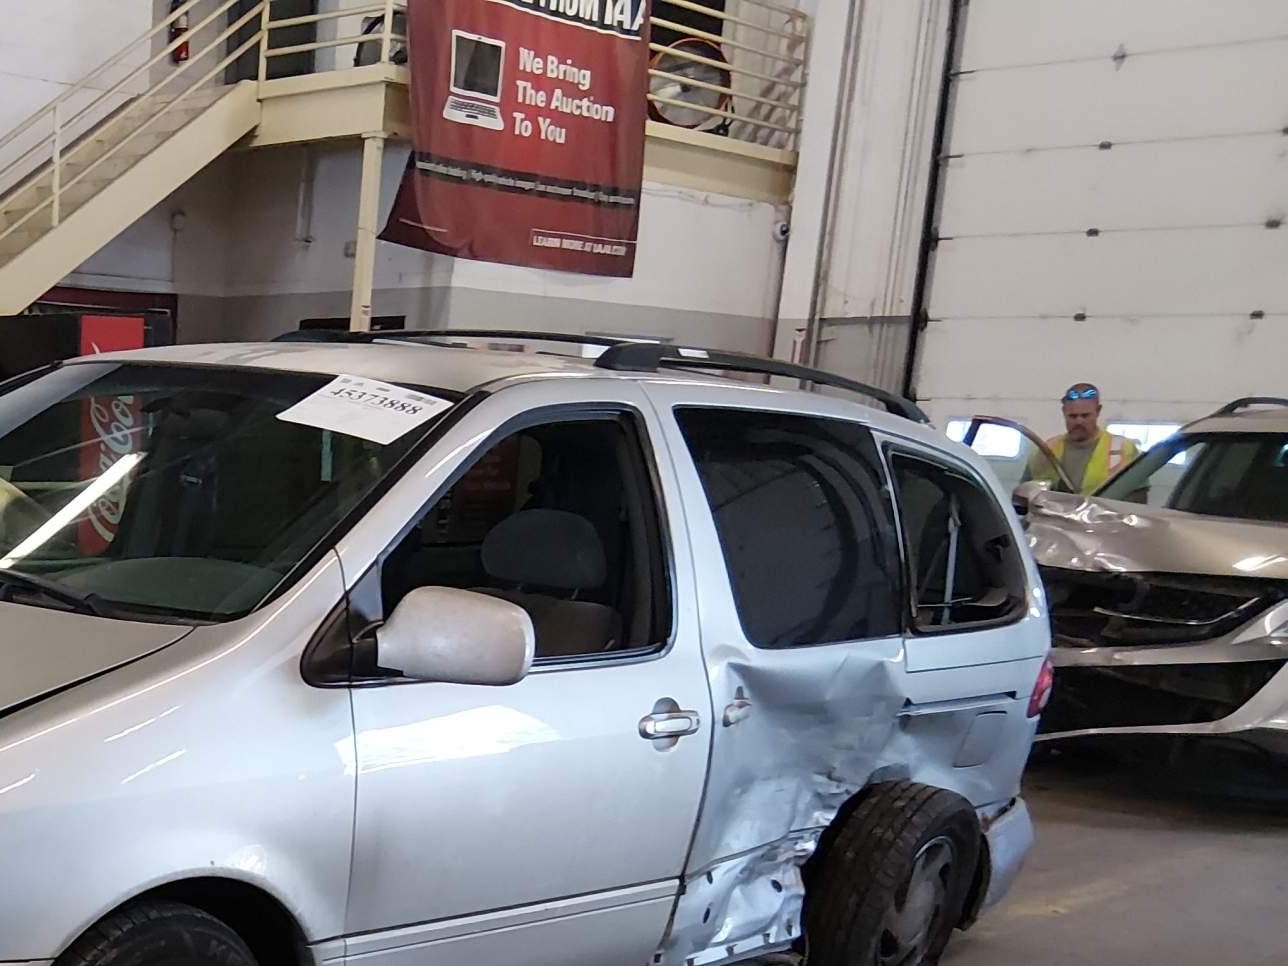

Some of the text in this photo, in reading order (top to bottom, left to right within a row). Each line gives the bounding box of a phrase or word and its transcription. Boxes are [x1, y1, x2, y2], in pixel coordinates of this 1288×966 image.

[547, 55, 591, 90] Bring
[516, 80, 615, 122] The Auction
[513, 112, 566, 143] To You
[331, 388, 423, 415] 45373888
